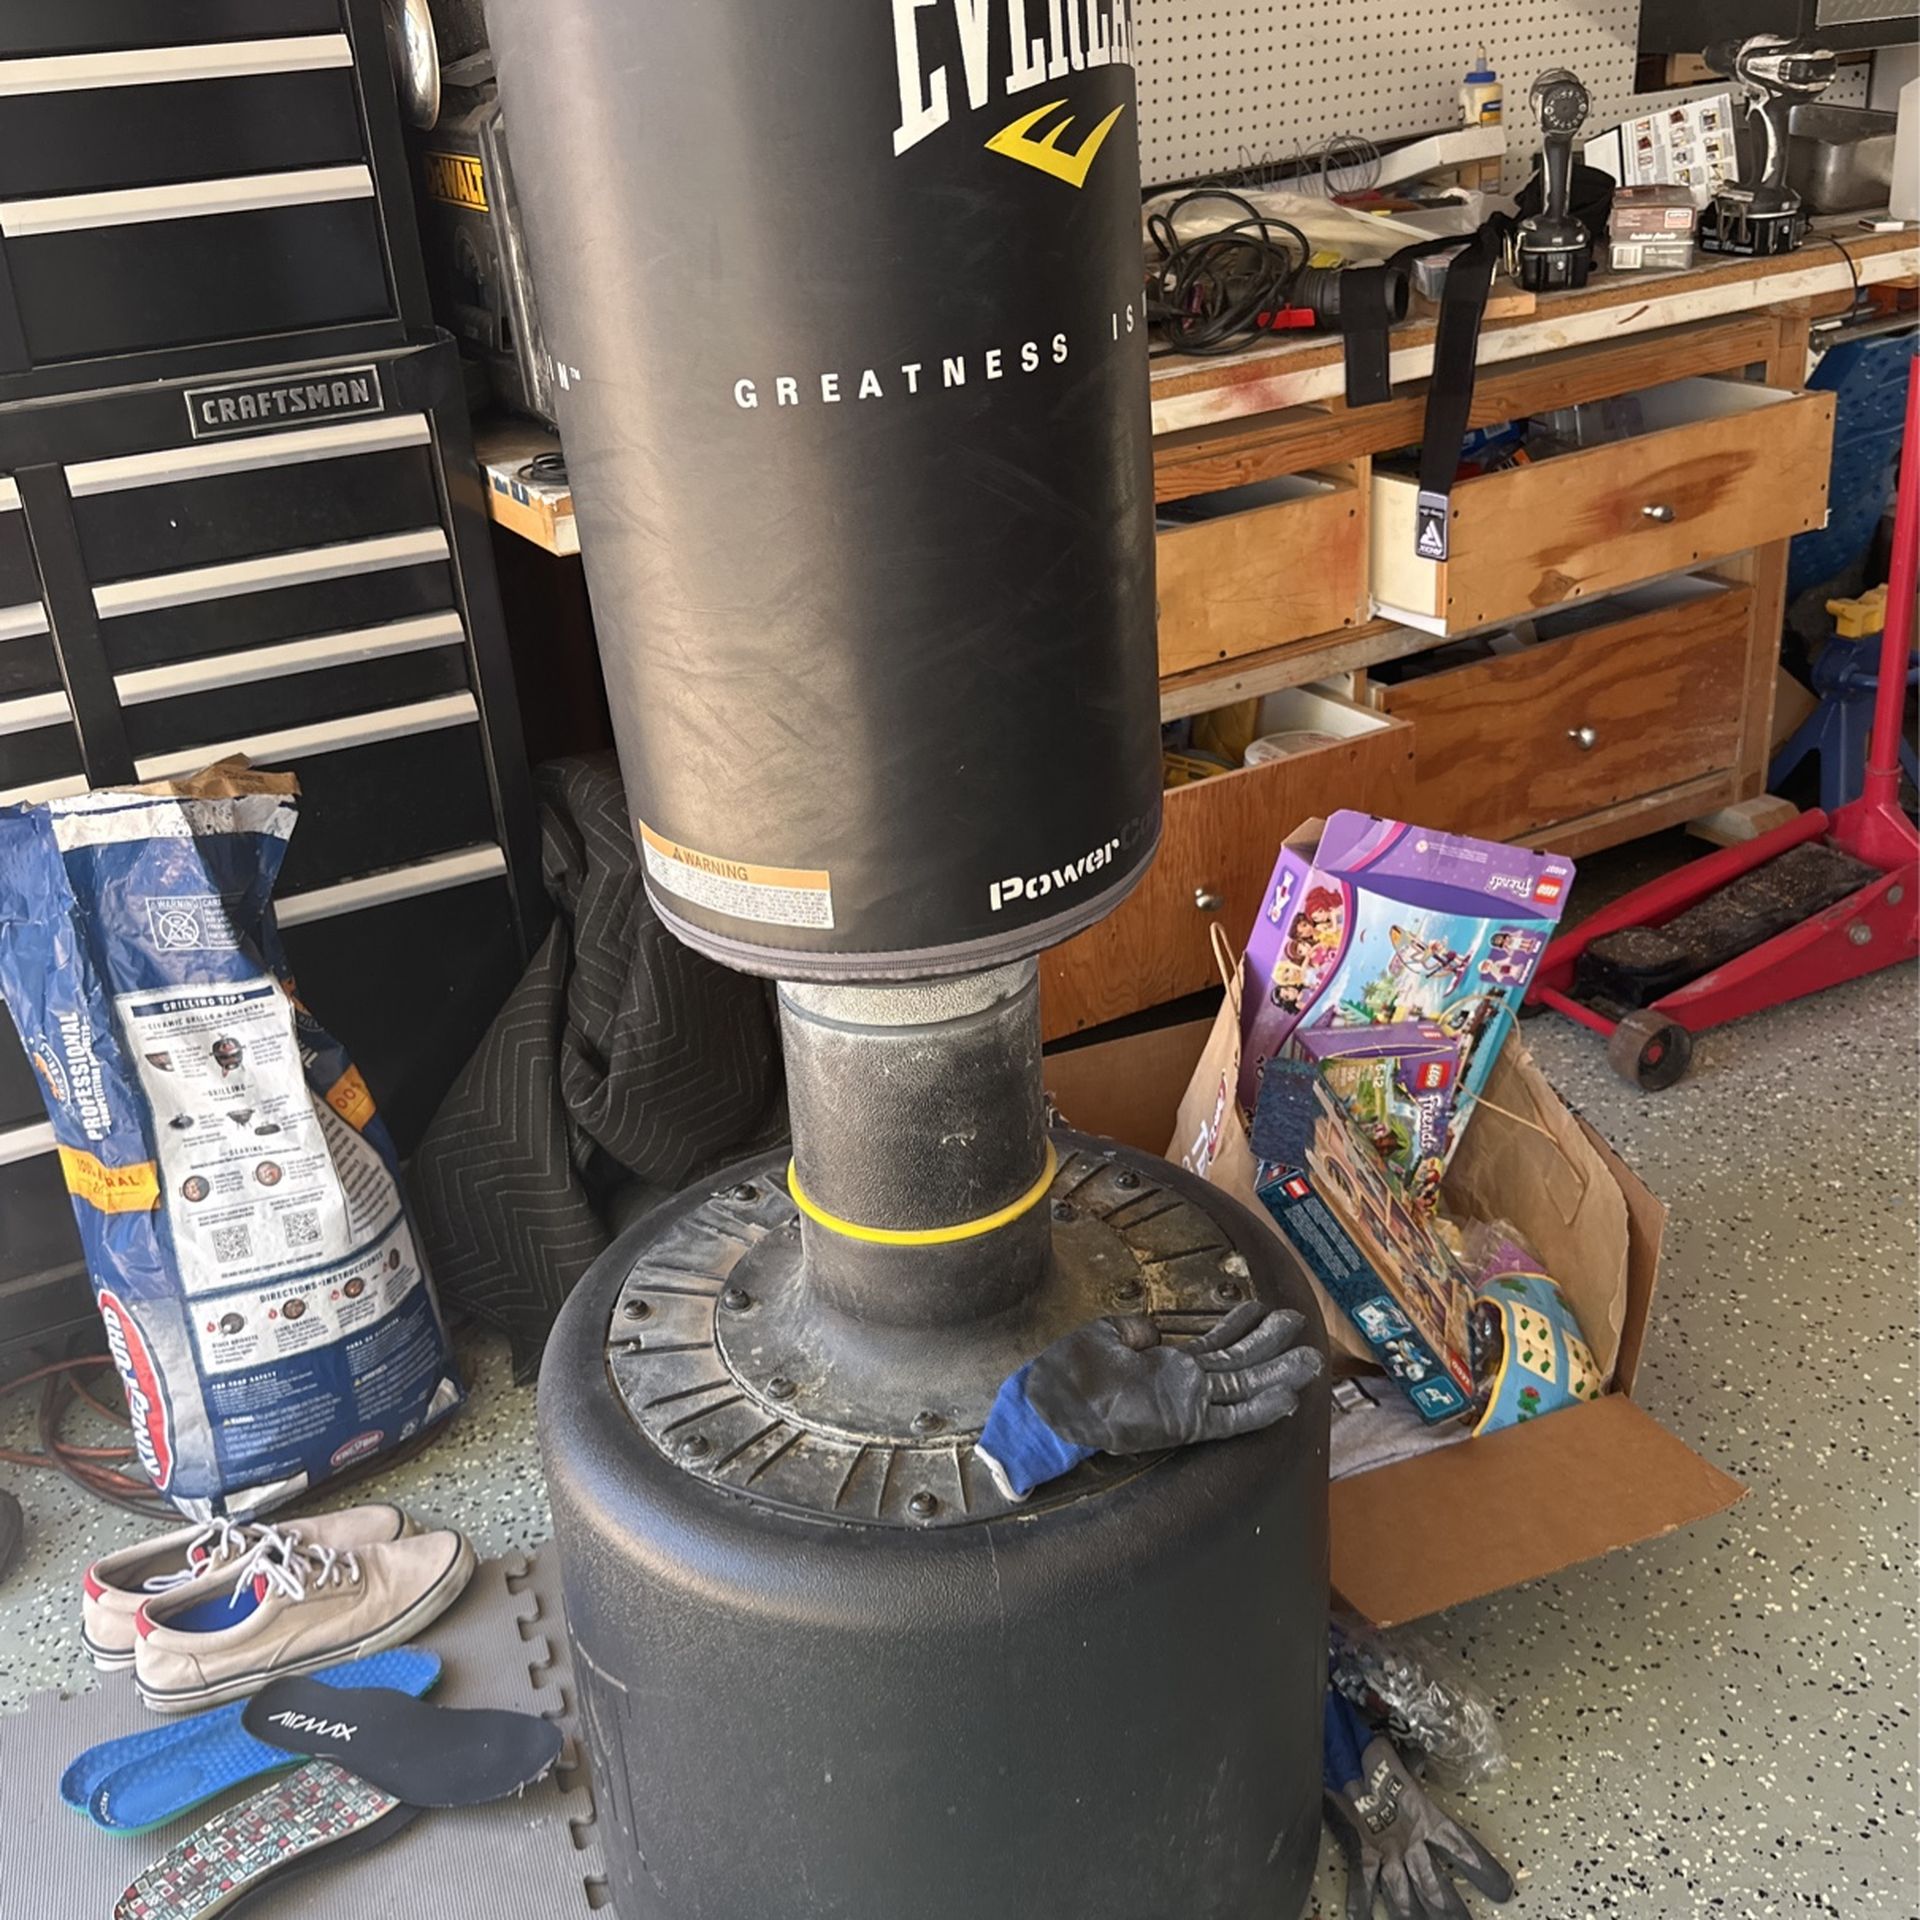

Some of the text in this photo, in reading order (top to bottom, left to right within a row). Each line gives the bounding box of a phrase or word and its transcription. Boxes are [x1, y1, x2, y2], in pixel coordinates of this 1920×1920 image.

[734, 333, 1069, 408] GREATNESS
[202, 378, 370, 424] CRAFTSMAN
[684, 850, 749, 881] WARNING
[162, 993, 245, 1012] GRILLING TIPS
[59, 1011, 104, 1141] PROFESSIONAL
[1425, 1062, 1443, 1088] LEGO
[259, 1281, 318, 1303] DIRECTIONS
[1353, 1760, 1390, 1814] KOALT
